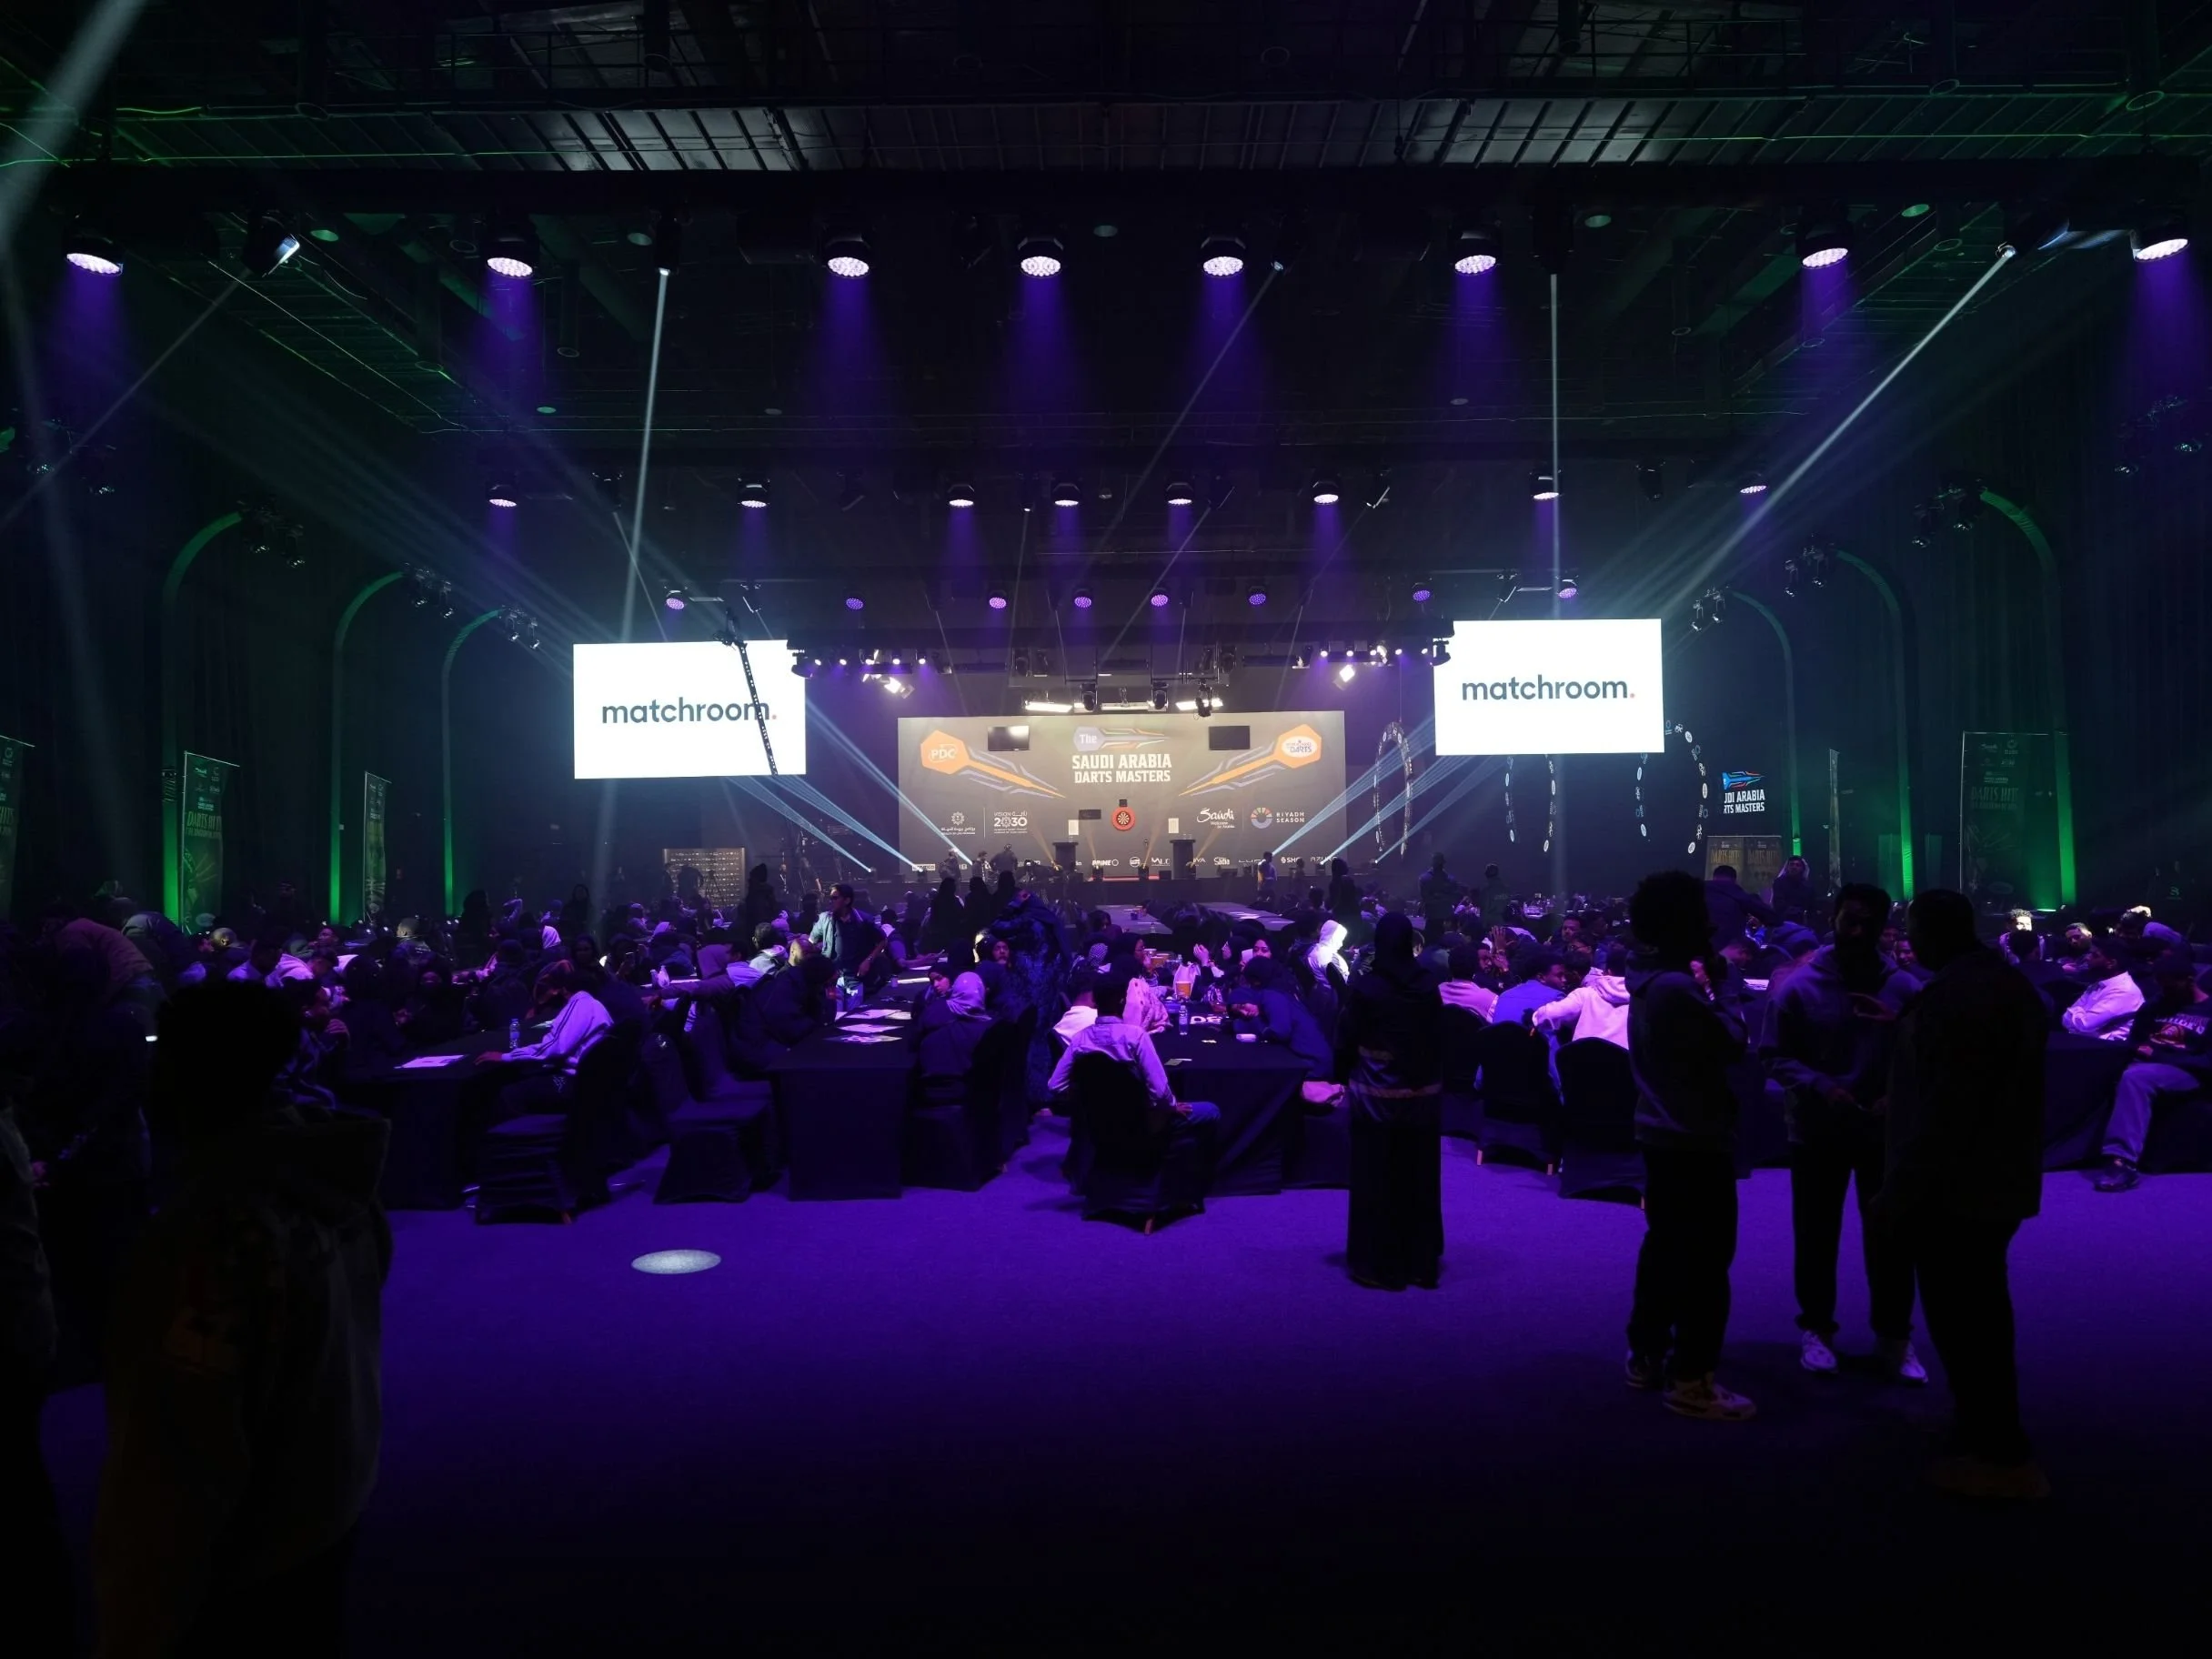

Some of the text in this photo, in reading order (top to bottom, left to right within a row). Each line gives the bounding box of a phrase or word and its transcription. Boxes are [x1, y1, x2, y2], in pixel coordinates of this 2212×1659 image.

[1462, 674, 1635, 700] matchroom.
[601, 697, 778, 724] matchroom.
[1079, 734, 1098, 744] The
[930, 748, 956, 760] PDC
[1071, 753, 1172, 769] SAUDI ARABIA
[1074, 769, 1171, 783] DARTS MASTERS
[1736, 789, 1765, 803] ARABIA
[1734, 802, 1765, 814] MASTERS
[993, 817, 1028, 828] 2030
